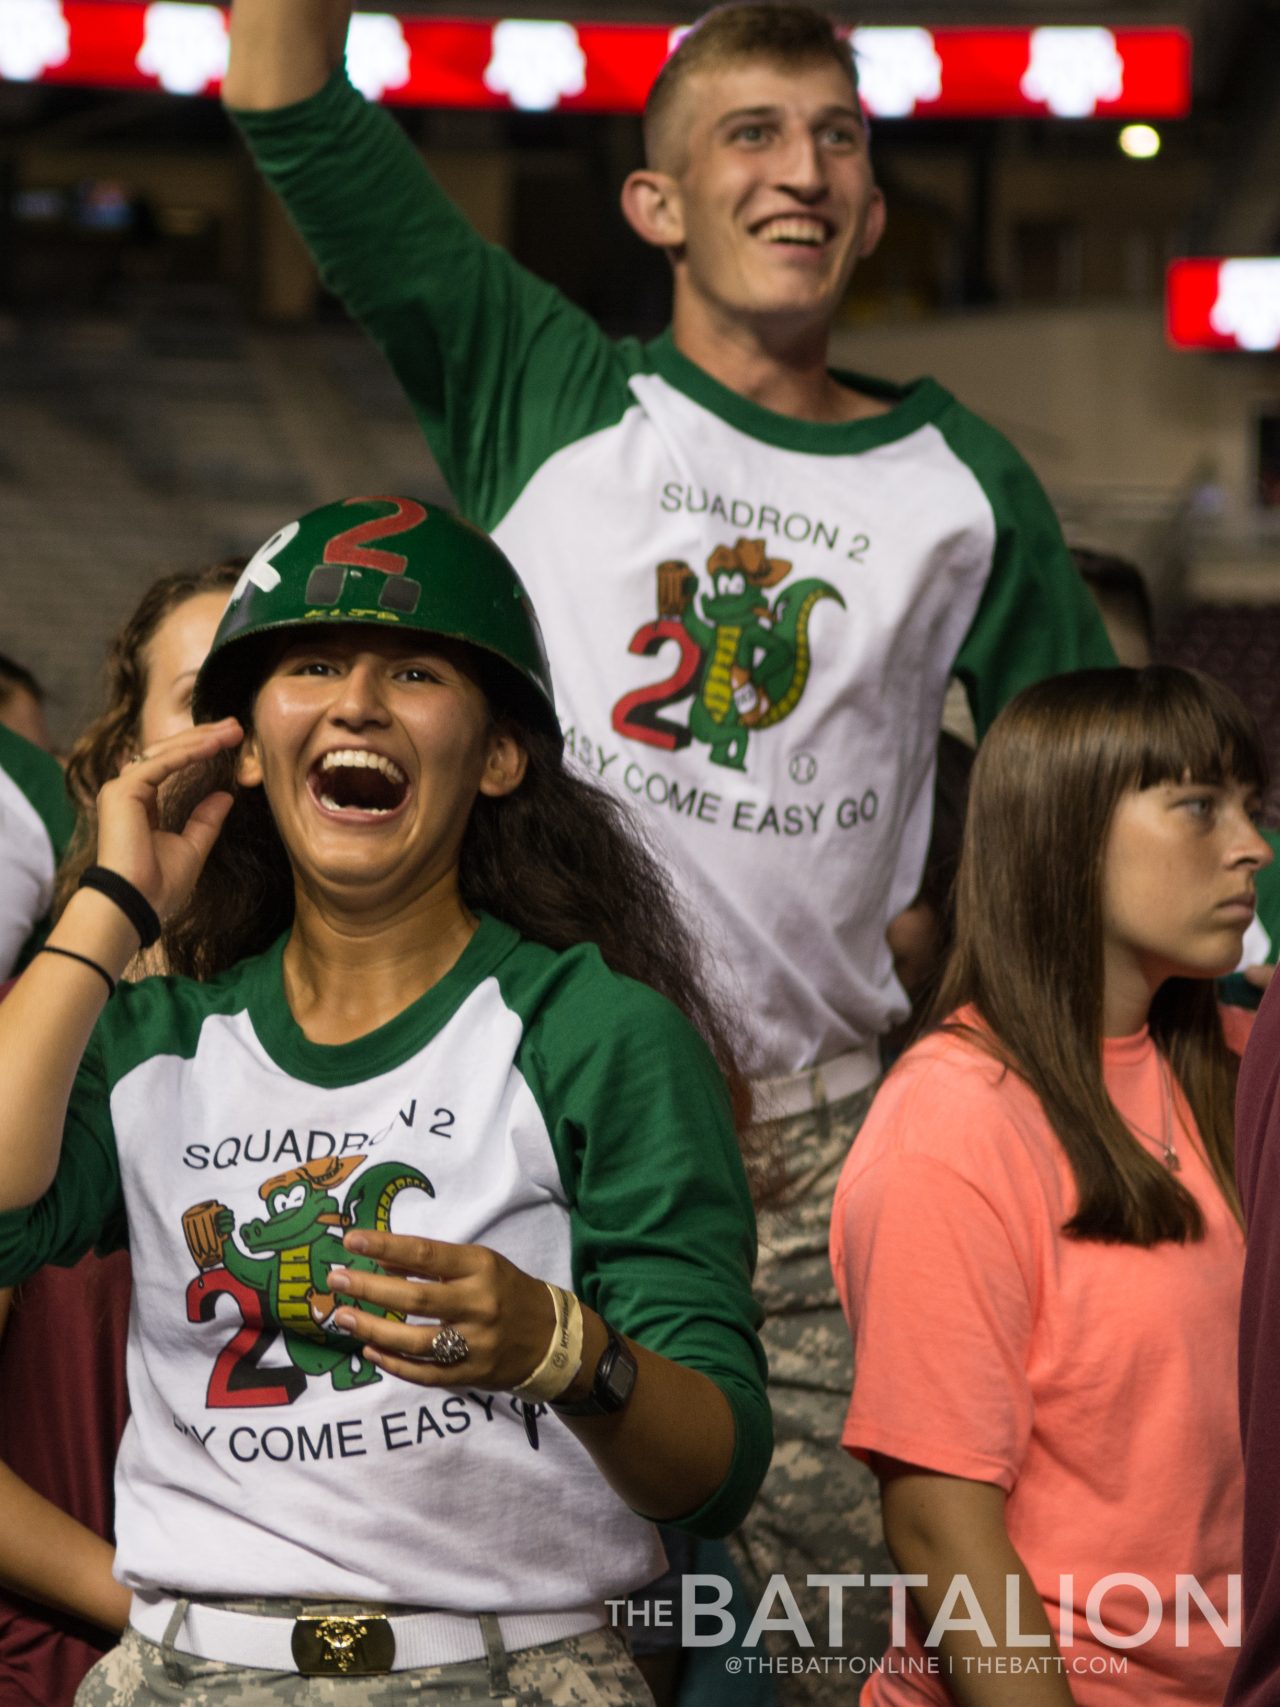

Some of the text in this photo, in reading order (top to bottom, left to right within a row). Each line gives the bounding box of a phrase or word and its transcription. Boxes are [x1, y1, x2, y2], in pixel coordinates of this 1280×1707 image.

[323, 495, 428, 575] 2
[847, 534, 870, 564] 2
[611, 620, 693, 752] 2
[563, 724, 878, 836] ASY COME EASY GO
[429, 1108, 456, 1138] 2
[185, 1266, 308, 1409] 2
[228, 1419, 367, 1463] COME
[381, 1391, 494, 1451] EASY
